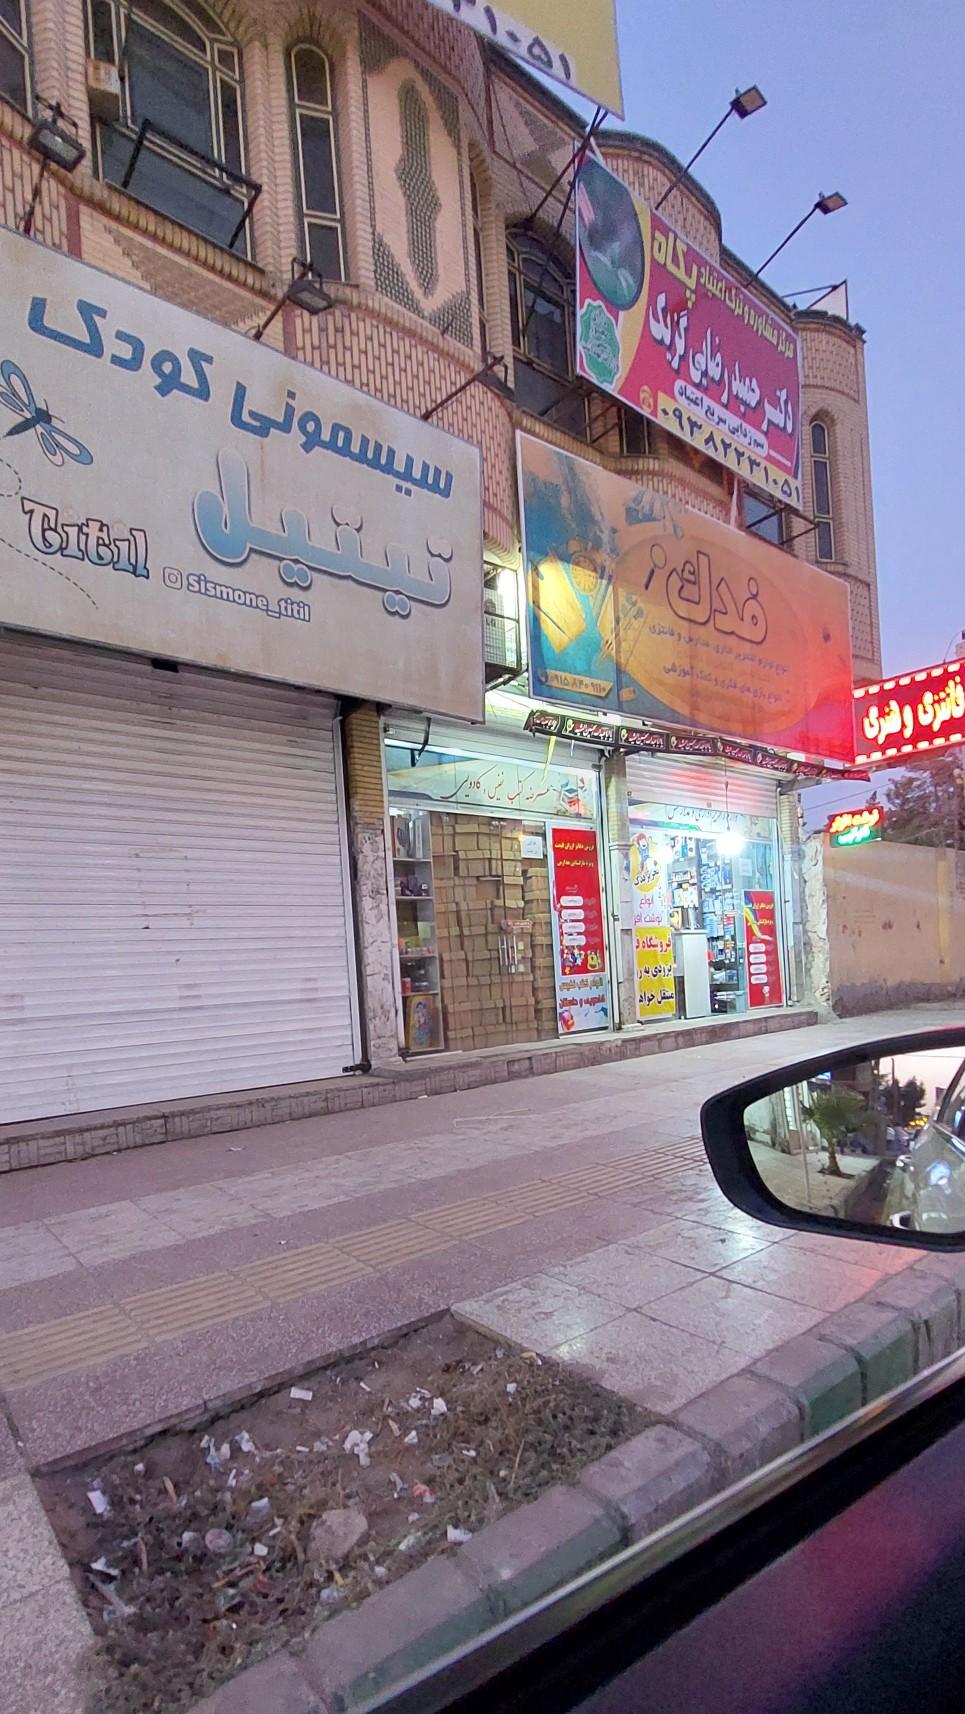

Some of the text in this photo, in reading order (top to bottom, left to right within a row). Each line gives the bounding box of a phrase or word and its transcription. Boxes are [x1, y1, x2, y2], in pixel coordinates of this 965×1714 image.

[689, 327, 729, 406] رضایی
[731, 360, 760, 414] حمید
[27, 296, 454, 499] سیسمونی کودک
[761, 387, 793, 434] دکتر
[193, 448, 453, 617] تیتیل
[186, 573, 311, 622] Sismone_titil
[902, 703, 914, 739] و
